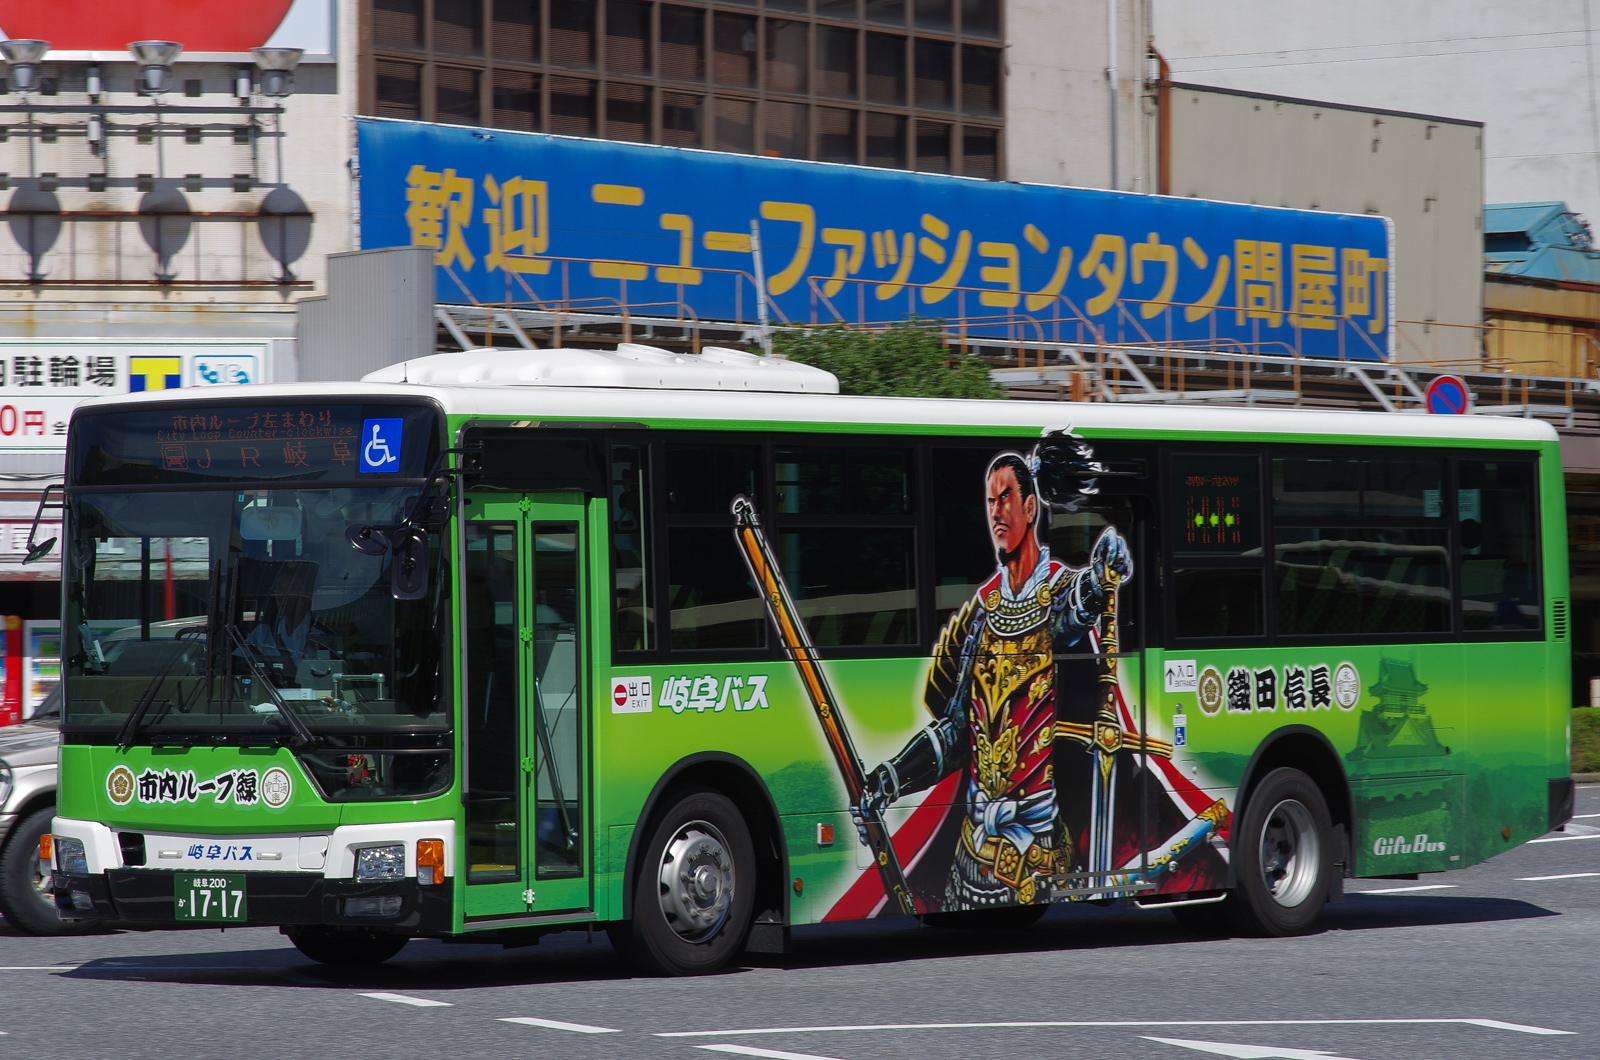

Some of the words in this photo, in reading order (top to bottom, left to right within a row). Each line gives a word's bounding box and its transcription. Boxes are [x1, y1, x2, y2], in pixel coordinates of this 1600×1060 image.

[404, 164, 552, 276] 歓迎
[588, 183, 1389, 336] ニューファッションタウン問屋町
[0, 355, 117, 388] 駐輪場
[171, 409, 332, 431] 市内ループ左まわり
[157, 430, 185, 442] City
[192, 429, 221, 441] Loop
[228, 425, 354, 439] Counter-clockwise
[1176, 664, 1194, 678] 入口
[628, 681, 651, 697] 出口
[658, 674, 770, 714] 岐阜バス
[631, 699, 648, 708] EXIT
[138, 770, 259, 804] 市内ループ線
[187, 844, 253, 860] 岐阜バス
[177, 898, 186, 907] か
[190, 889, 243, 918] 17-17
